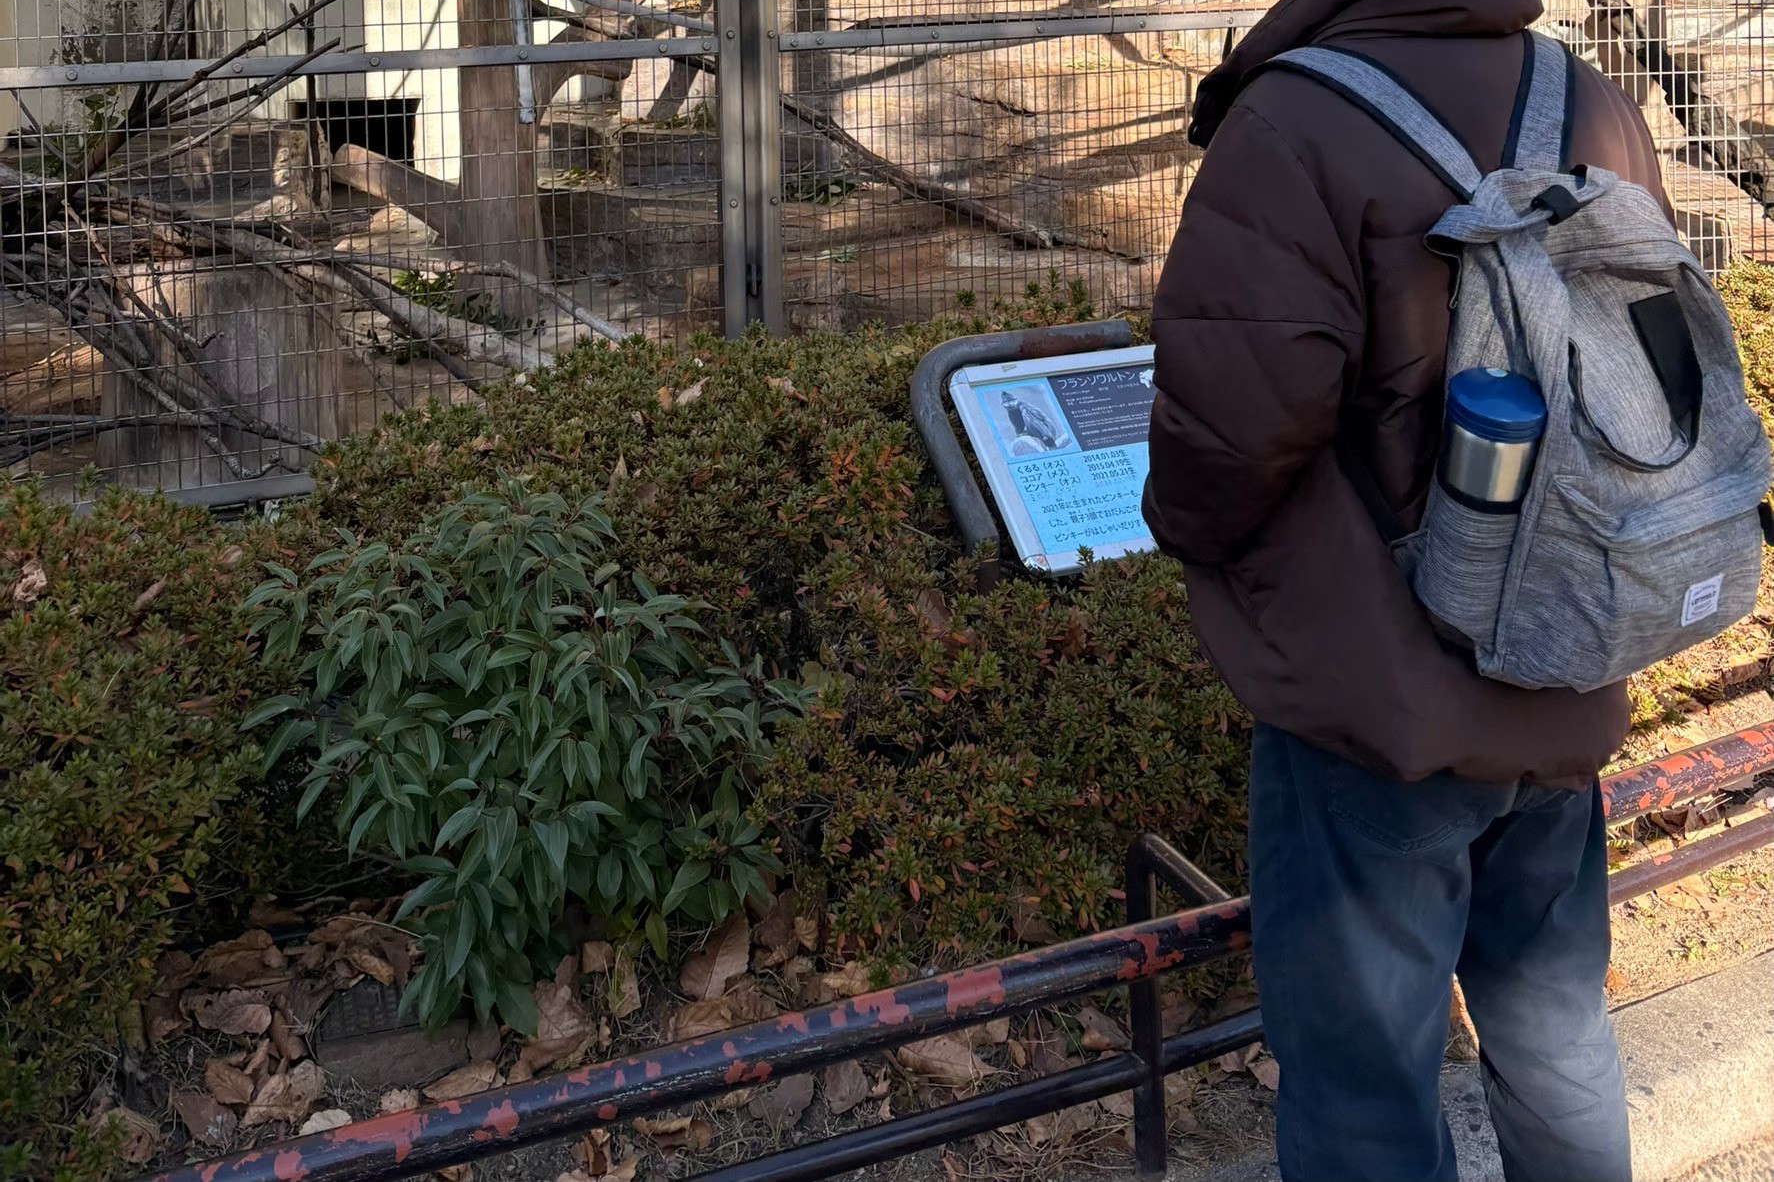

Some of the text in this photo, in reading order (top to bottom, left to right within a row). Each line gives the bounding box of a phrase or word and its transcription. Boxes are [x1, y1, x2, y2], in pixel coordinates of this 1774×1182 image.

[1057, 371, 1135, 390] フランソワルトン
